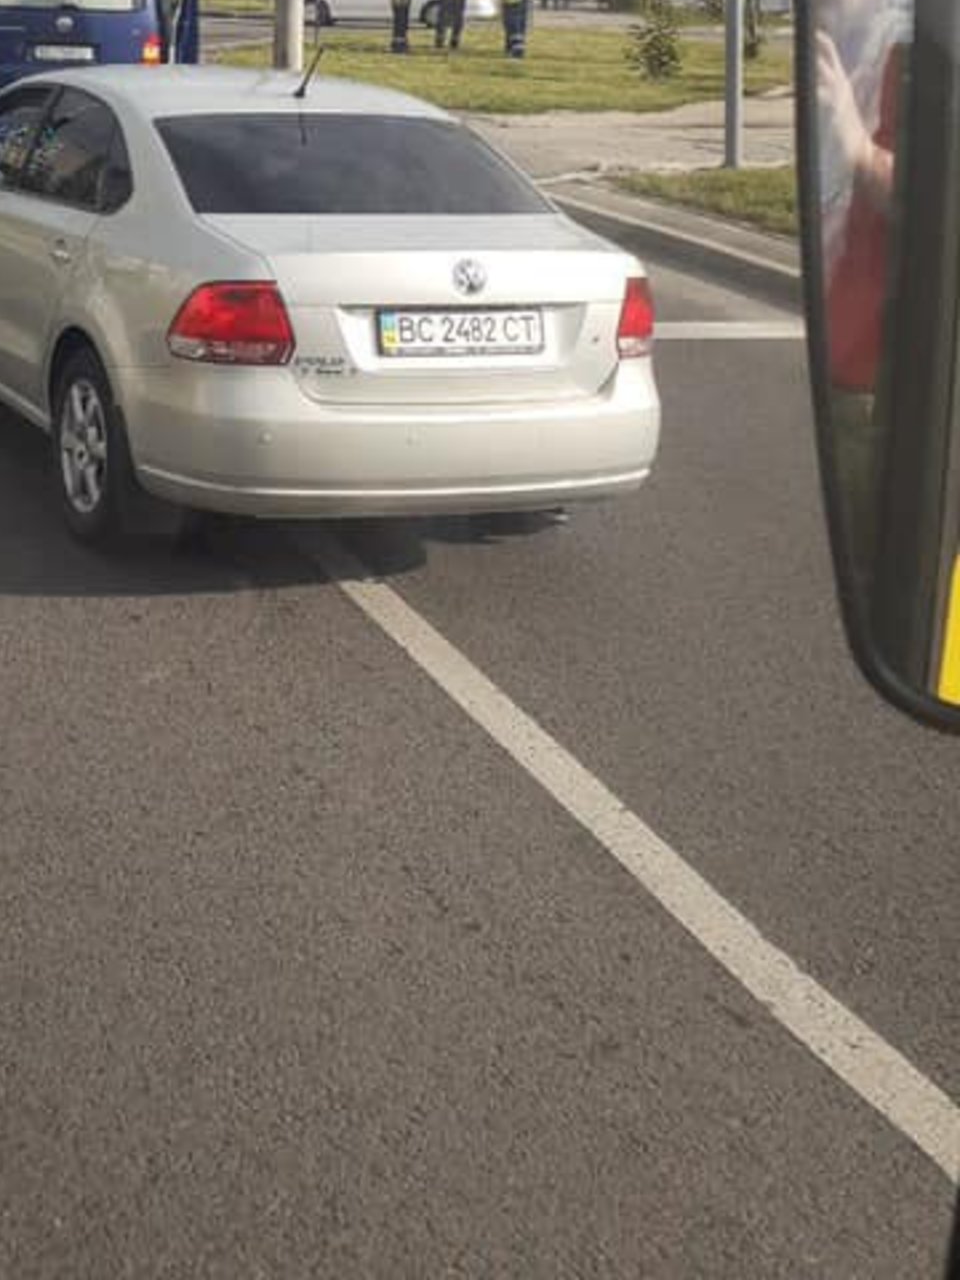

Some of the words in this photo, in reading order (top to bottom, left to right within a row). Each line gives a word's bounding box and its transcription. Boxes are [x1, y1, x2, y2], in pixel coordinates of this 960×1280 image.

[399, 316, 433, 343] BC
[442, 316, 497, 343] 2482
[503, 315, 535, 342] CT
